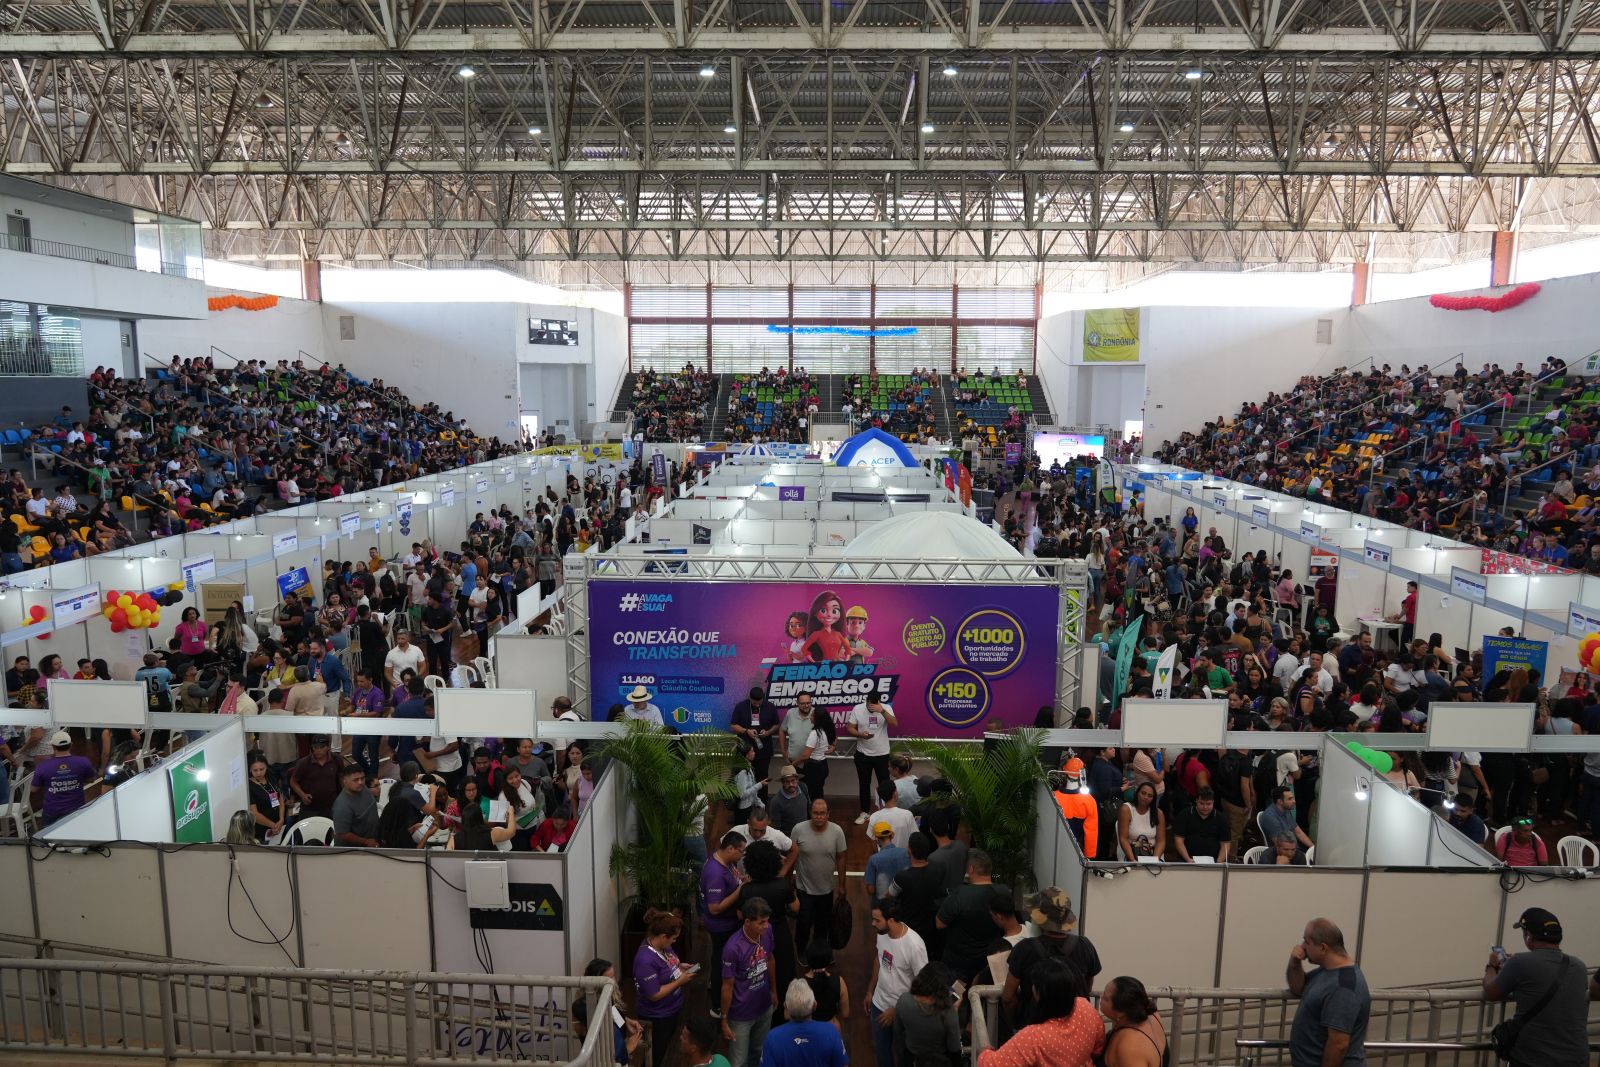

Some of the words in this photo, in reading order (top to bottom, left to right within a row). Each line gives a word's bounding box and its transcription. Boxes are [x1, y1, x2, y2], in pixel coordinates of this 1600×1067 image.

[871, 457, 896, 465] ACEP
[911, 622, 936, 631] EVENTO
[613, 627, 689, 645] CONEXÃO
[692, 631, 720, 644] QUE
[908, 628, 940, 637] GRATUITO
[907, 635, 932, 643] ABERTO
[933, 633, 943, 641] AO
[628, 644, 737, 660] TRANSFORMA
[964, 645, 1014, 653] Oportunidades
[772, 660, 848, 680] FEIRÃO
[852, 664, 875, 676] DO
[622, 675, 655, 684] 11.AGO
[661, 684, 688, 692] Cláudio
[769, 678, 875, 696] EMPREGO
[877, 677, 892, 692] E
[935, 682, 977, 699] +150
